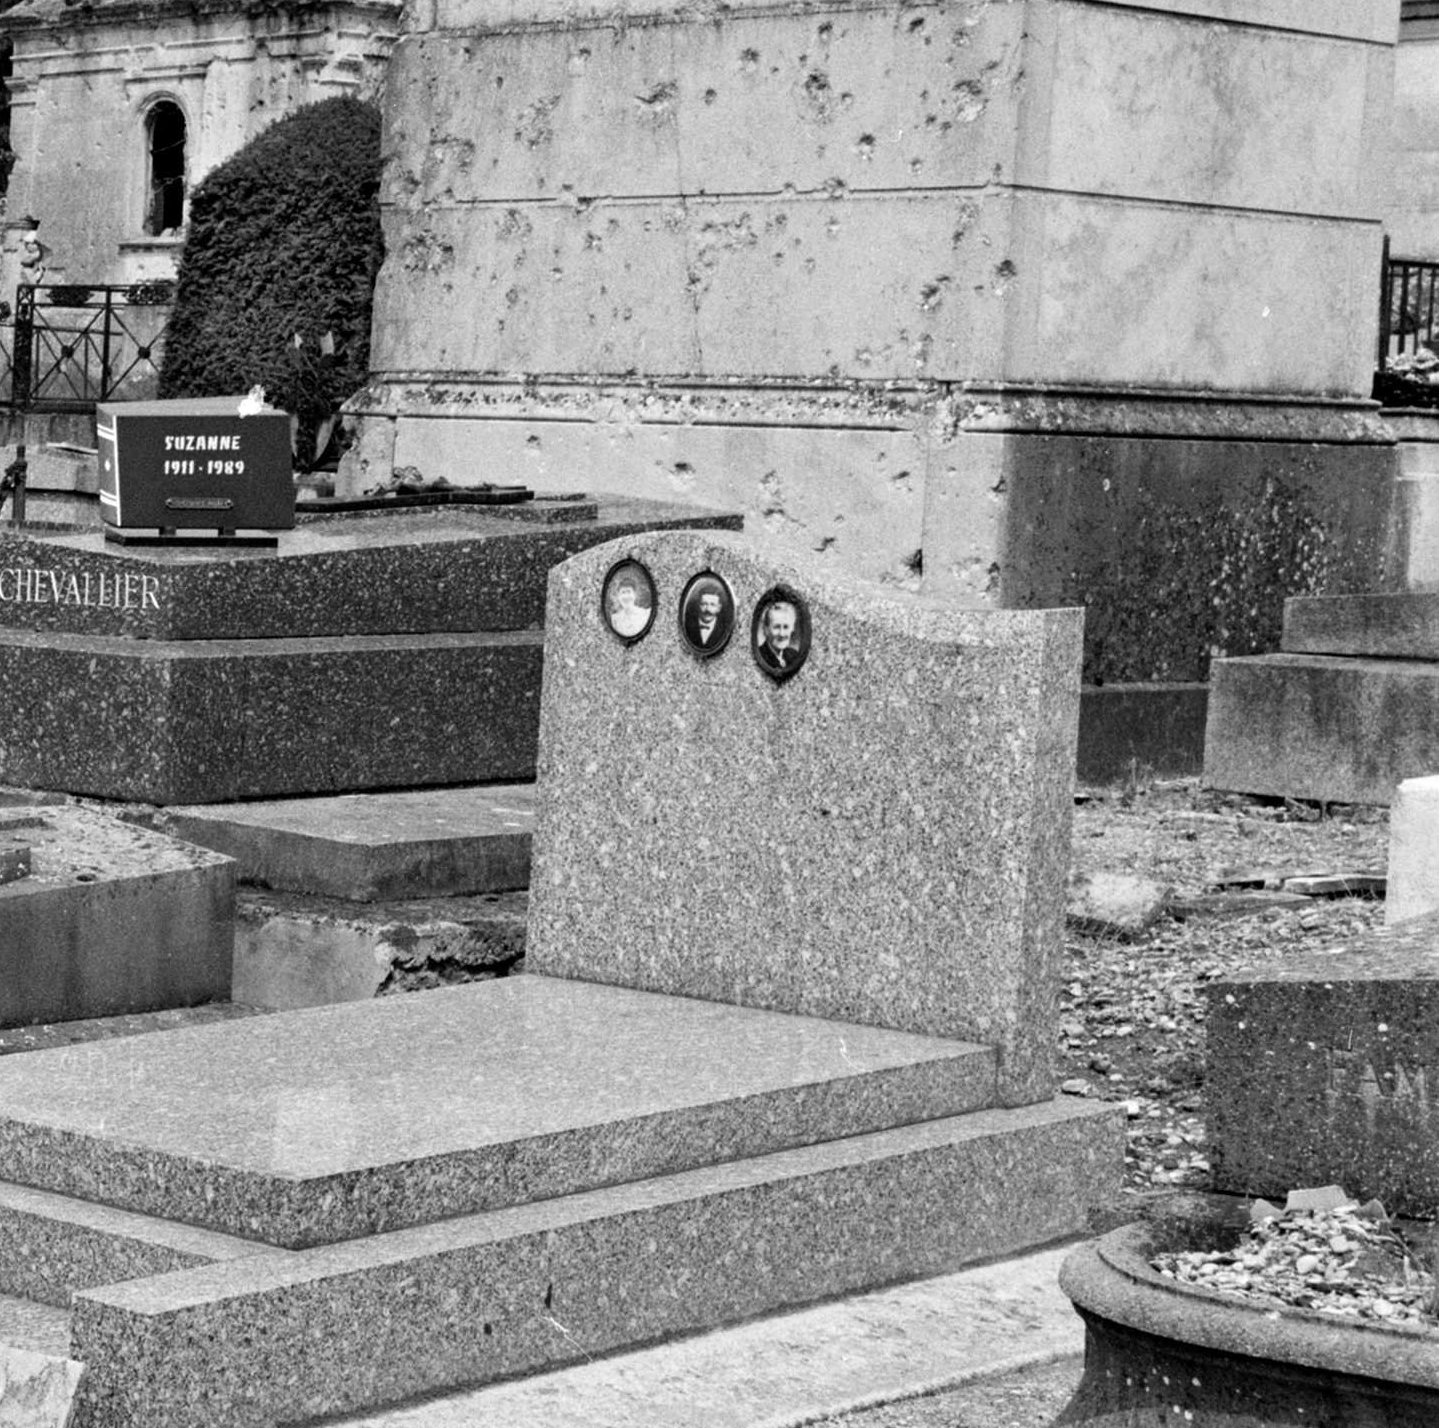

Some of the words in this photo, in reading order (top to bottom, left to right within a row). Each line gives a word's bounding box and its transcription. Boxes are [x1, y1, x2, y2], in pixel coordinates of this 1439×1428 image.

[165, 435, 241, 451] SUZANNE
[164, 460, 195, 475] 1911
[207, 460, 245, 475] 1989
